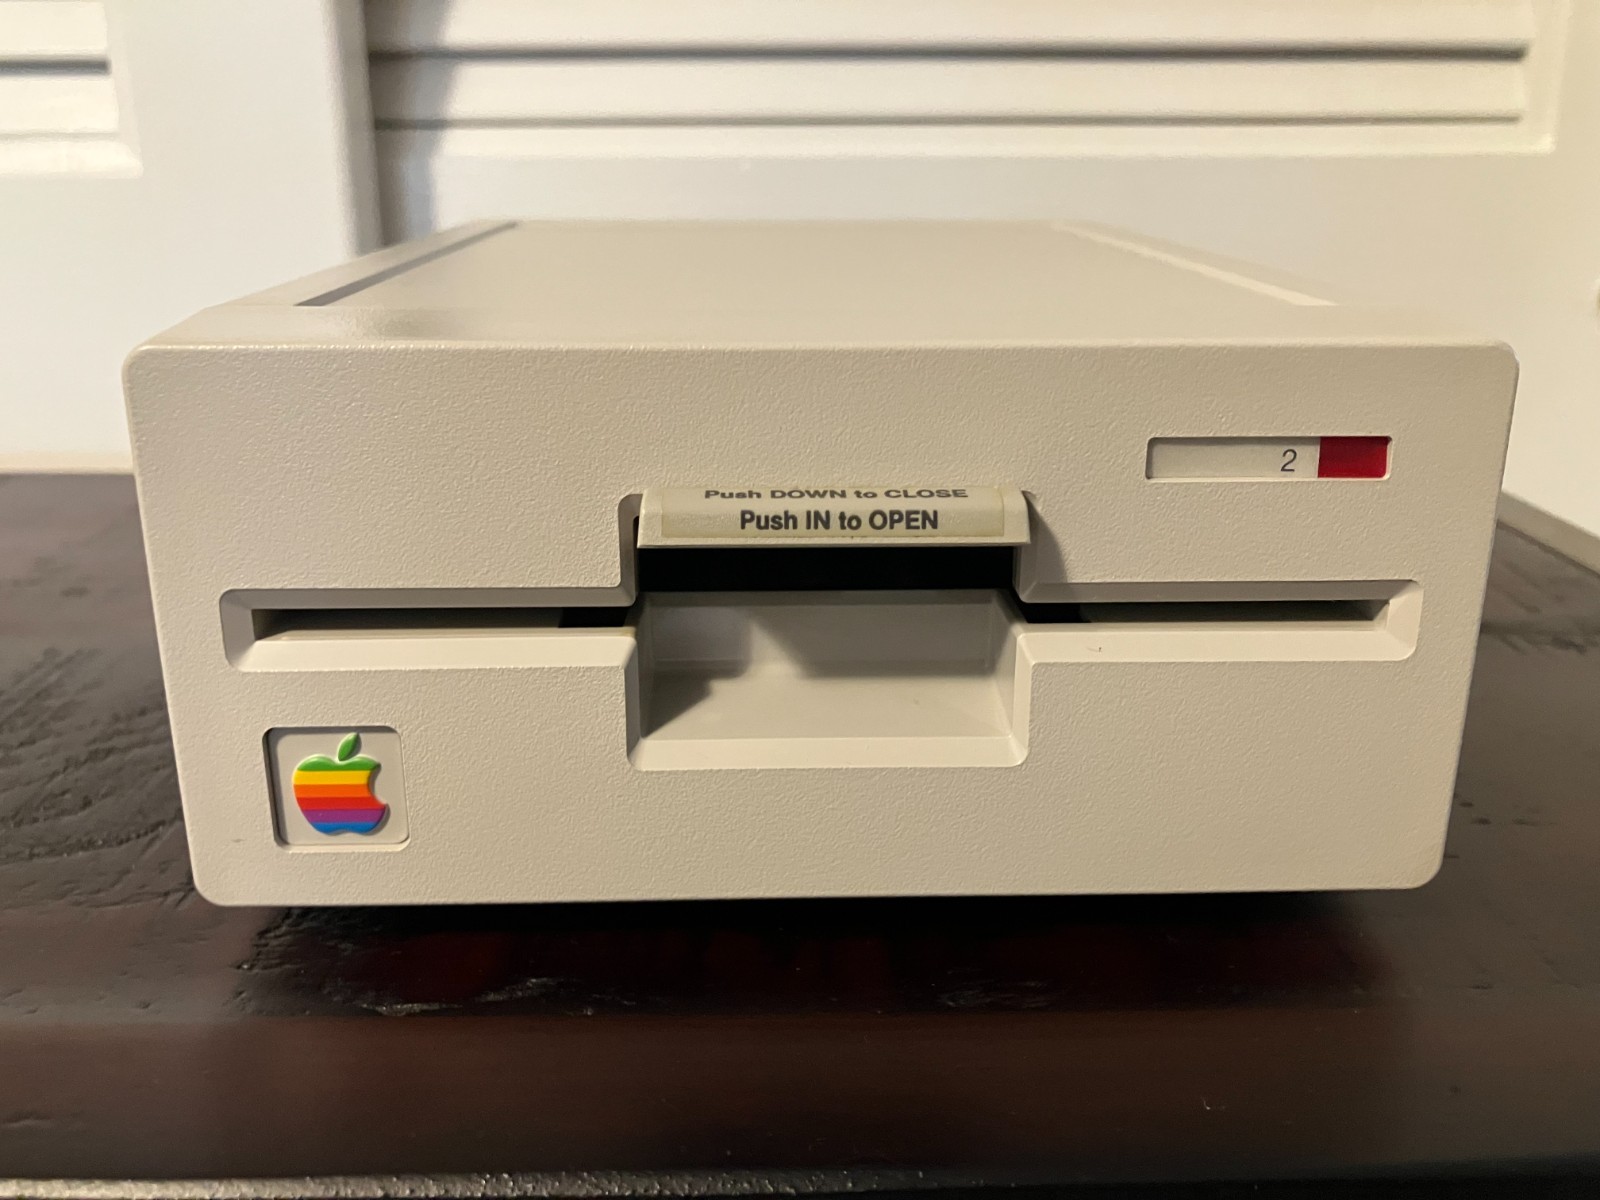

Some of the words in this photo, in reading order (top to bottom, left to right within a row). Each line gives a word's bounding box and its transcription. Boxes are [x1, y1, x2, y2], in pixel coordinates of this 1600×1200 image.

[1280, 449, 1297, 472] 2
[704, 489, 762, 499] Push
[770, 489, 847, 499] DOWN
[854, 489, 877, 499] to
[884, 488, 969, 498] CLOSE
[740, 509, 798, 531] Push
[805, 510, 831, 530] IN
[838, 510, 862, 530] to
[868, 509, 939, 530] OPEN
